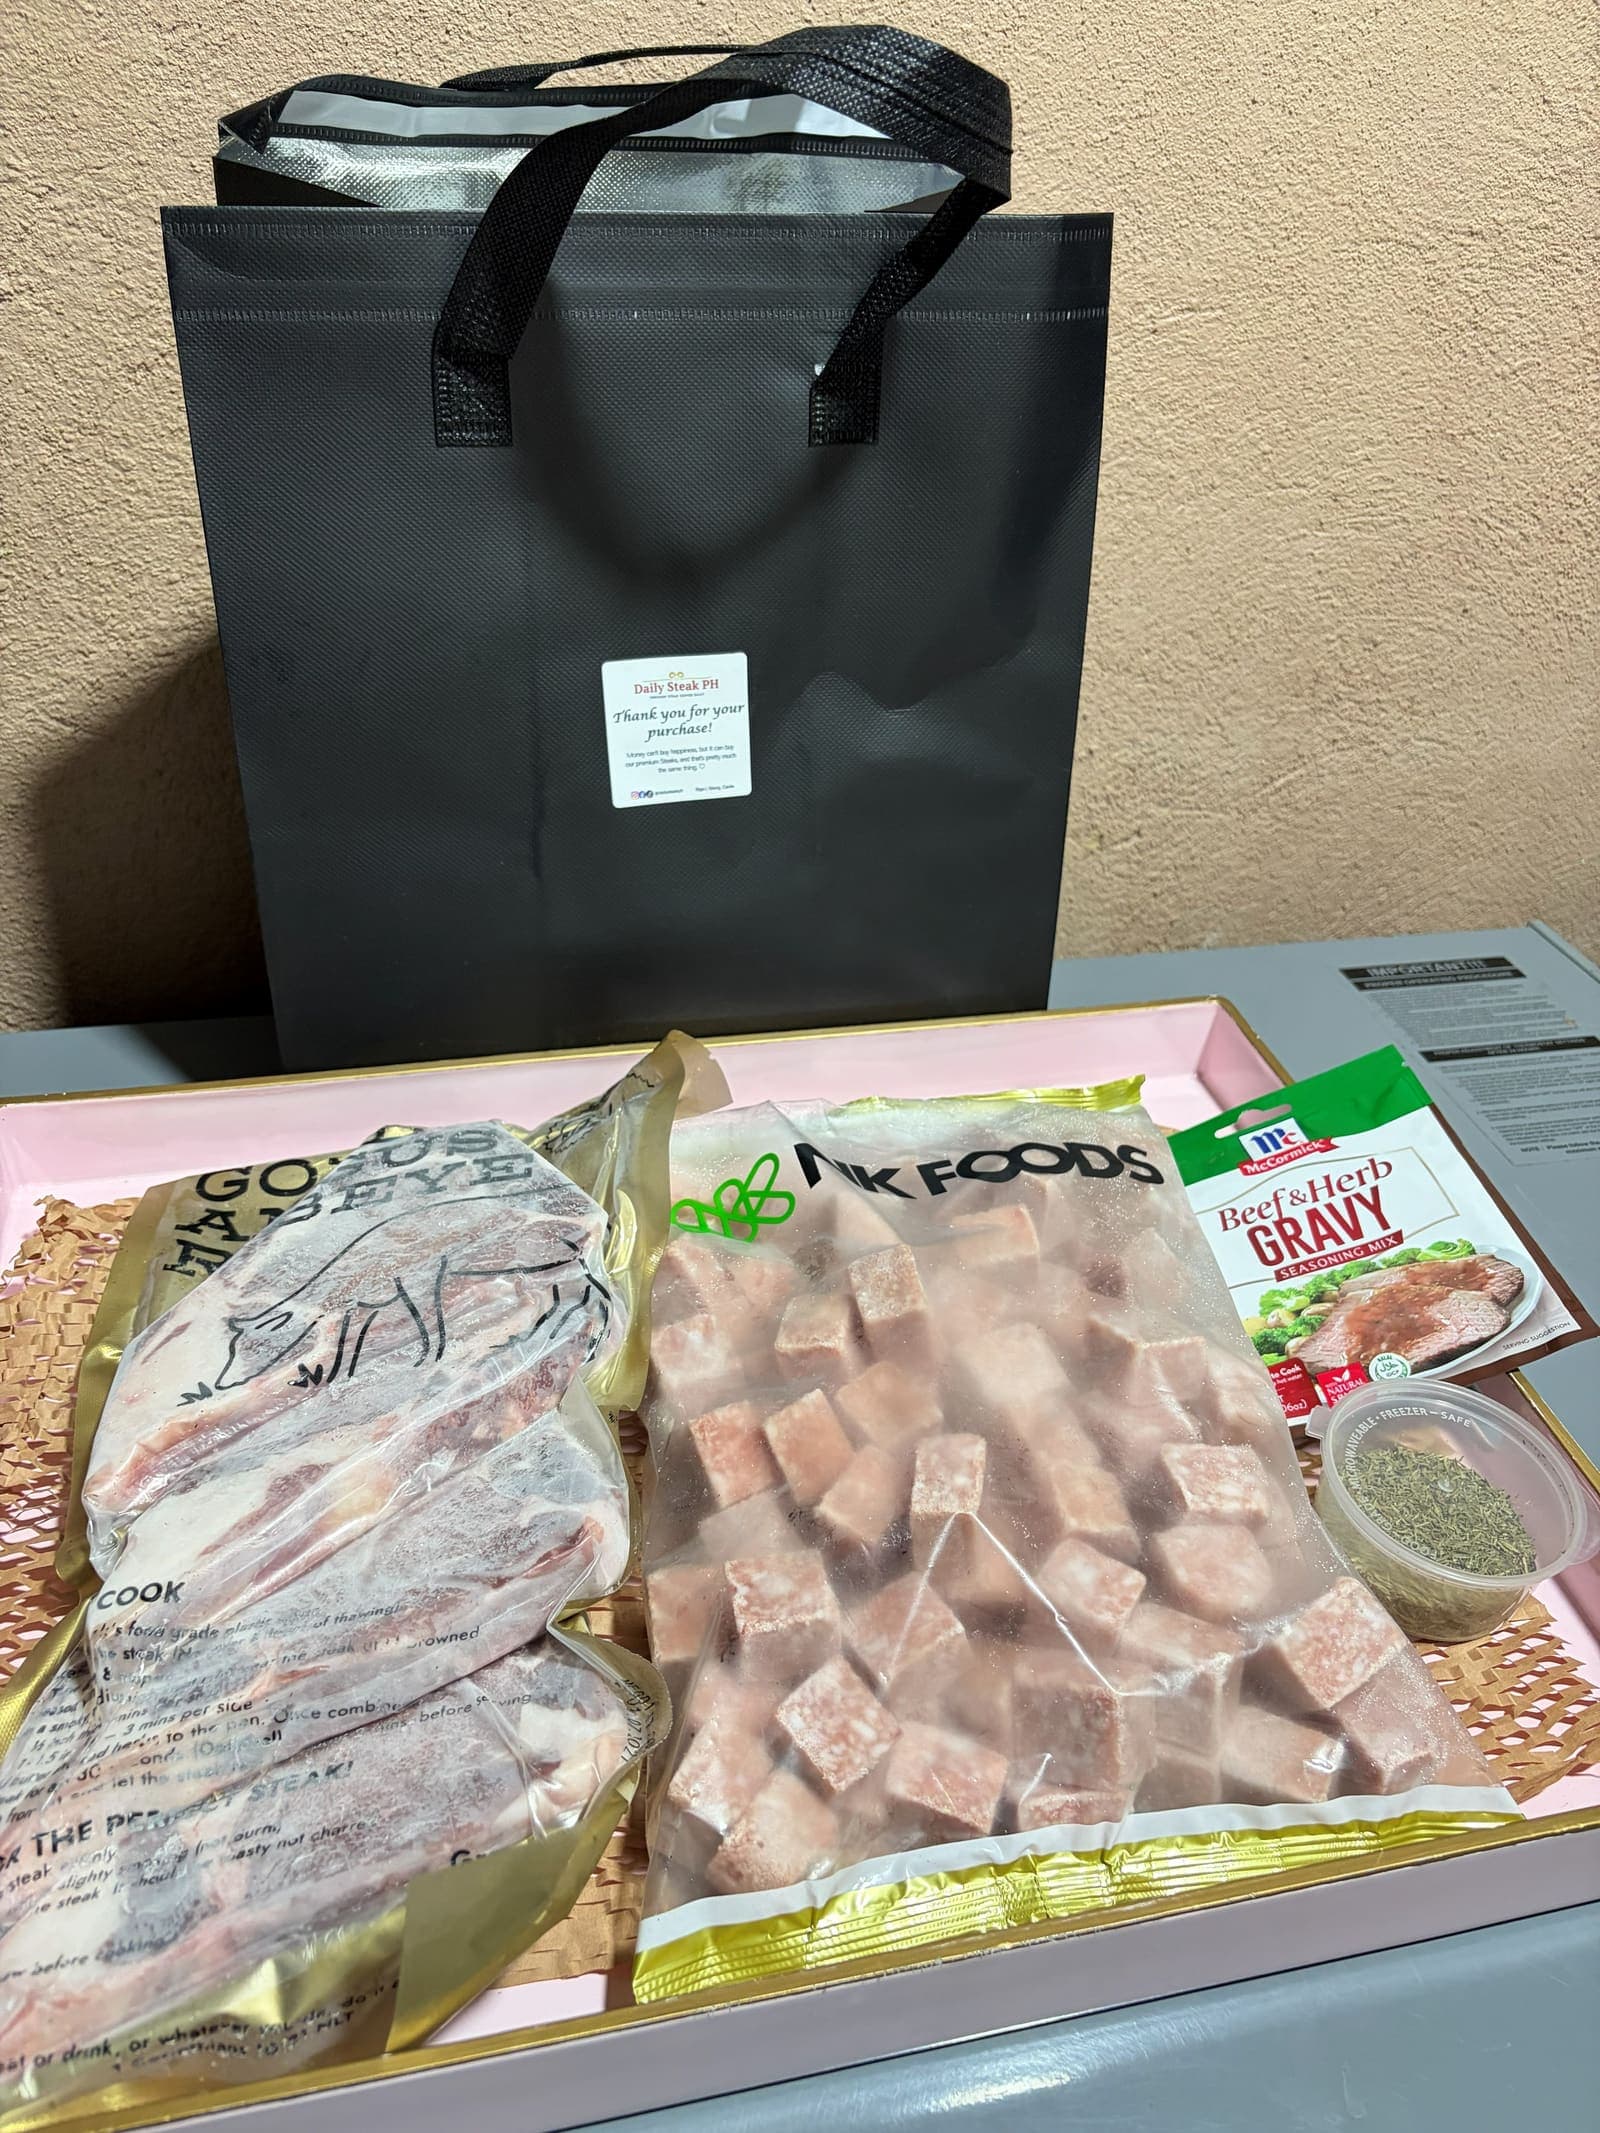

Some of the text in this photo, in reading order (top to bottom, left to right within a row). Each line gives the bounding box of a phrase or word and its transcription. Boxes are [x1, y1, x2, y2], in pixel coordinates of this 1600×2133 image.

[634, 679, 719, 695] Daily Steak PH
[613, 704, 745, 724] Thank you for your
[645, 722, 712, 742] purchase!
[917, 1142, 1165, 1196] FOODS
[1242, 1140, 1326, 1175] McCormick
[1218, 1157, 1393, 1232] Beef & Herb
[1246, 1184, 1392, 1267] GRAVY
[1279, 1235, 1399, 1279] SEASONING MIX
[1502, 1322, 1571, 1351] SERVING SUGGESTION
[1280, 1364, 1302, 1376] Cook
[1327, 1378, 1365, 1396] NATURAL
[1344, 1407, 1473, 1490] MICROWAVEABLE FREEZER SAFE
[97, 1581, 185, 1610] COOK
[419, 1703, 473, 1723] before
[32, 1819, 93, 1858] THE
[34, 2053, 54, 2069] or
[62, 2038, 121, 2063] drink,
[128, 2039, 149, 2052] or
[158, 2023, 249, 2045] whatever
